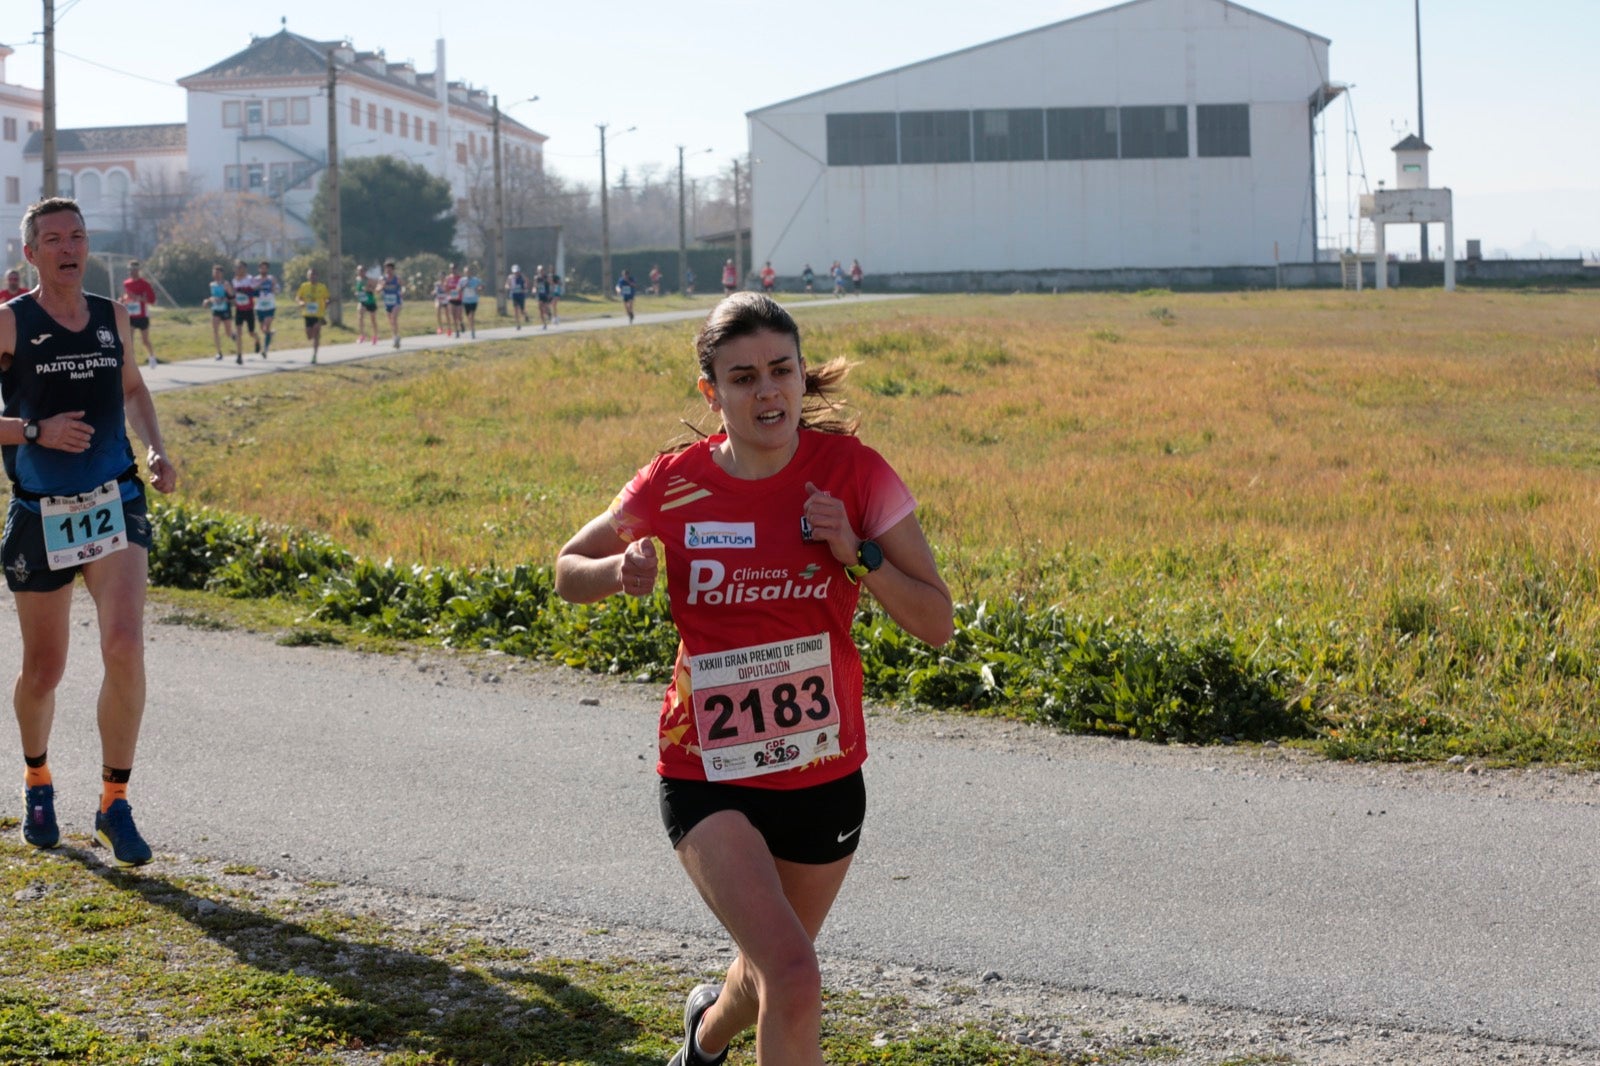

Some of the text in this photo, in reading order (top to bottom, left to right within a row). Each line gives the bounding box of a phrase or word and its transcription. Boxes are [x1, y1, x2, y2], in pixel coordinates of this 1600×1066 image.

[36, 361, 76, 374] PAZITO
[85, 357, 117, 369] PAZITO
[70, 370, 94, 379] Motril
[60, 508, 114, 544] 112
[686, 559, 832, 605] Polisalud
[732, 567, 789, 582] Clínicas
[698, 639, 823, 671] XXXIII GRAN PREMIO DE FONDO
[738, 660, 791, 680] DIPUTACIÓN
[704, 675, 831, 740] 2183
